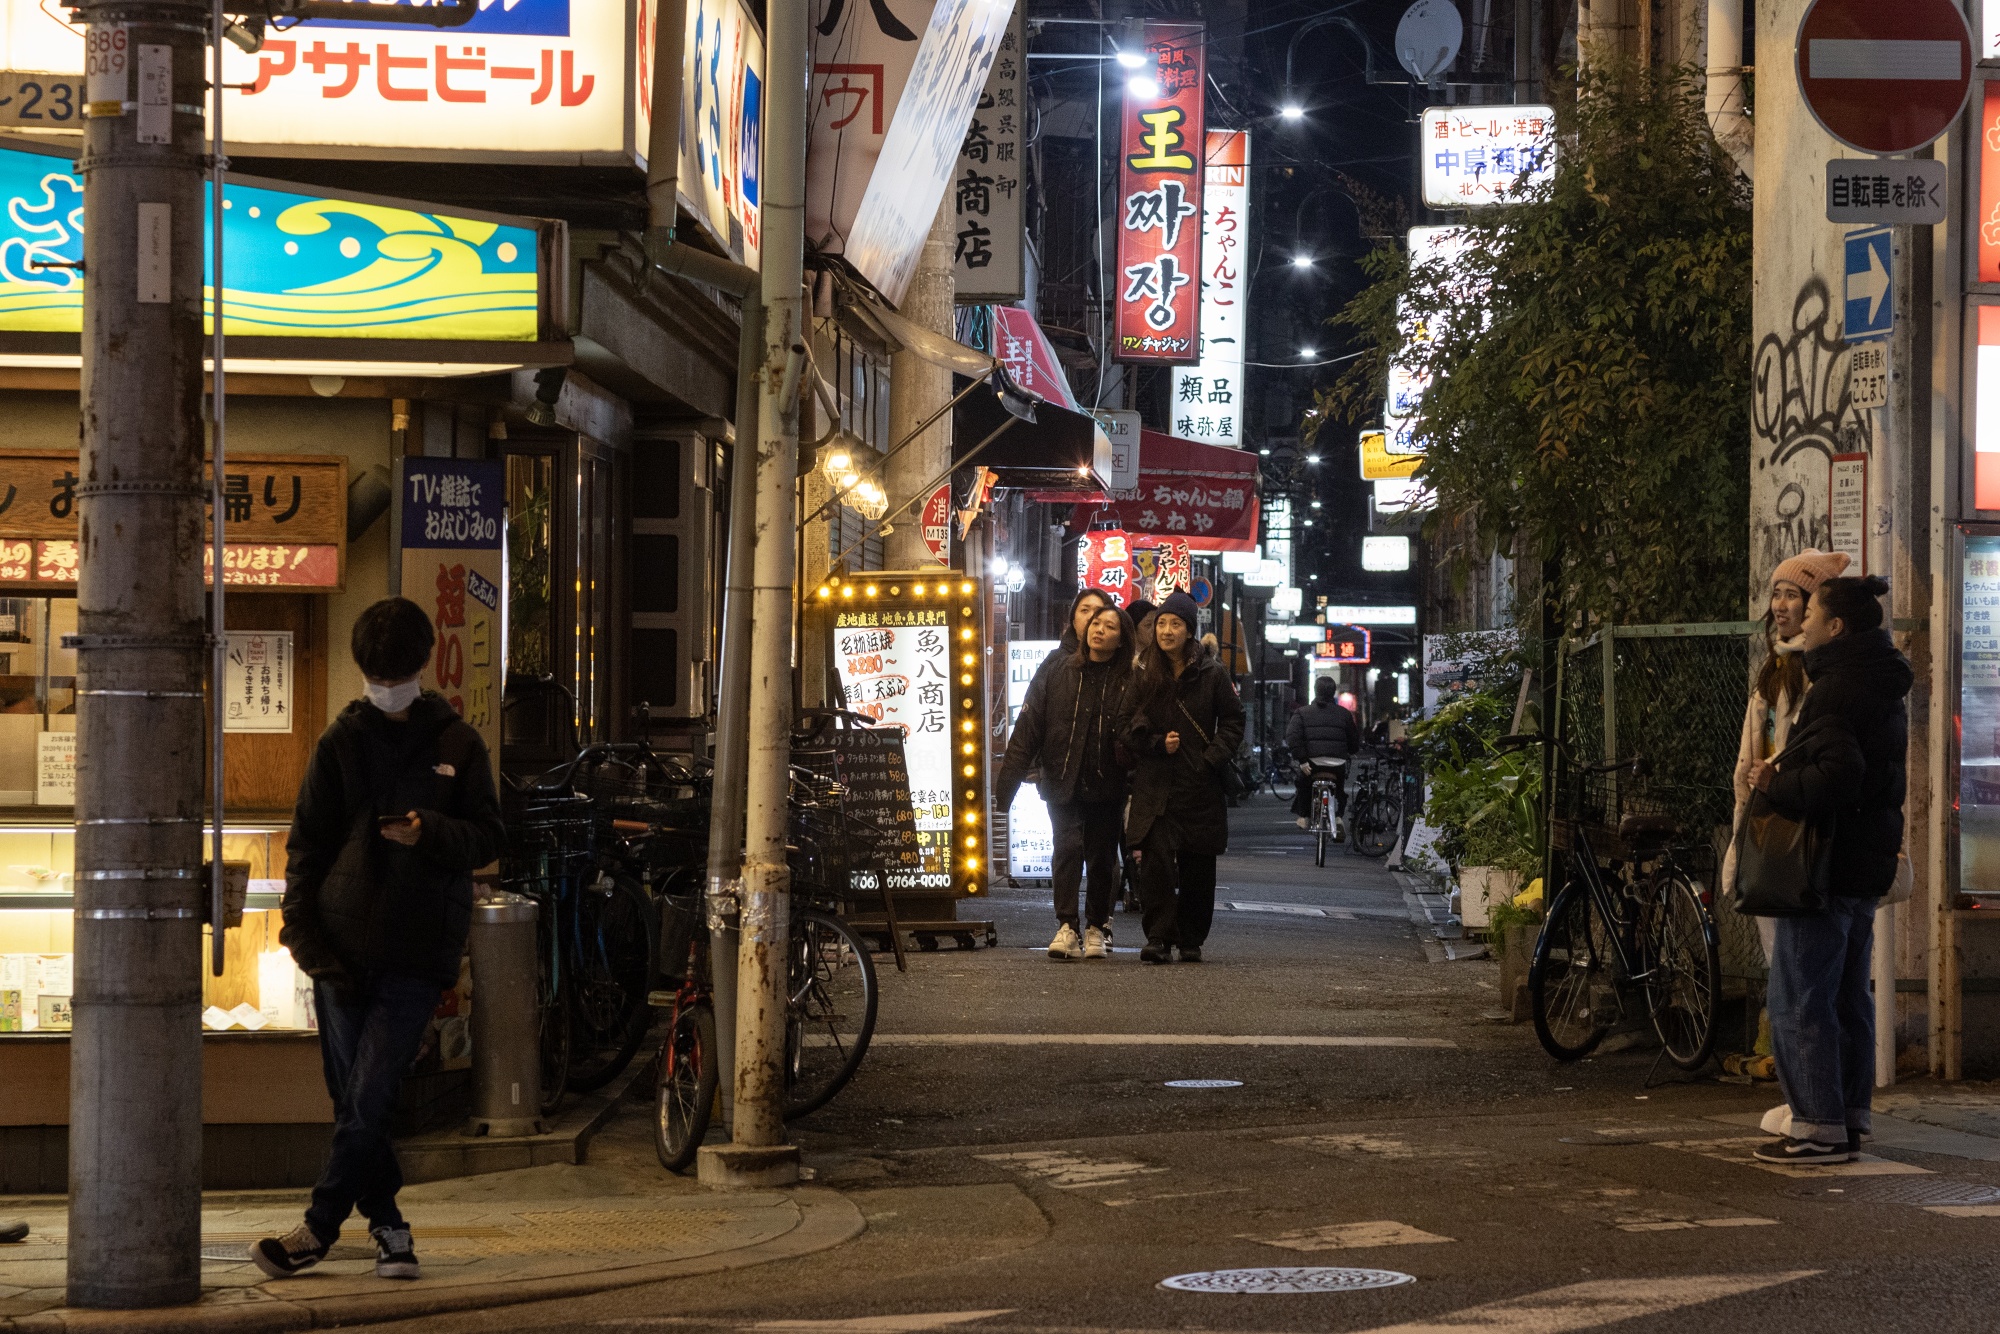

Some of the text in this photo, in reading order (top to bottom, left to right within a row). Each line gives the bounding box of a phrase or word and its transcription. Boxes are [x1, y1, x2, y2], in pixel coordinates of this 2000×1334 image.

[241, 39, 595, 107] アサヒビール
[1206, 167, 1242, 184] RIN
[1833, 175, 1940, 208] 自転車を除く
[1853, 350, 1885, 371] 自転車を除く
[1853, 374, 1885, 402] ここまで
[410, 474, 482, 507] TV・雑誌で
[425, 509, 497, 541] おなじみの
[1139, 510, 1213, 532] みねや
[260, 666, 271, 715] お持ち帰り
[915, 629, 948, 733] 魚八商店
[888, 752, 902, 764] 680
[889, 769, 906, 783] 580
[896, 809, 913, 822] 680
[900, 851, 919, 864] 480
[886, 874, 950, 888] 6764-9090
